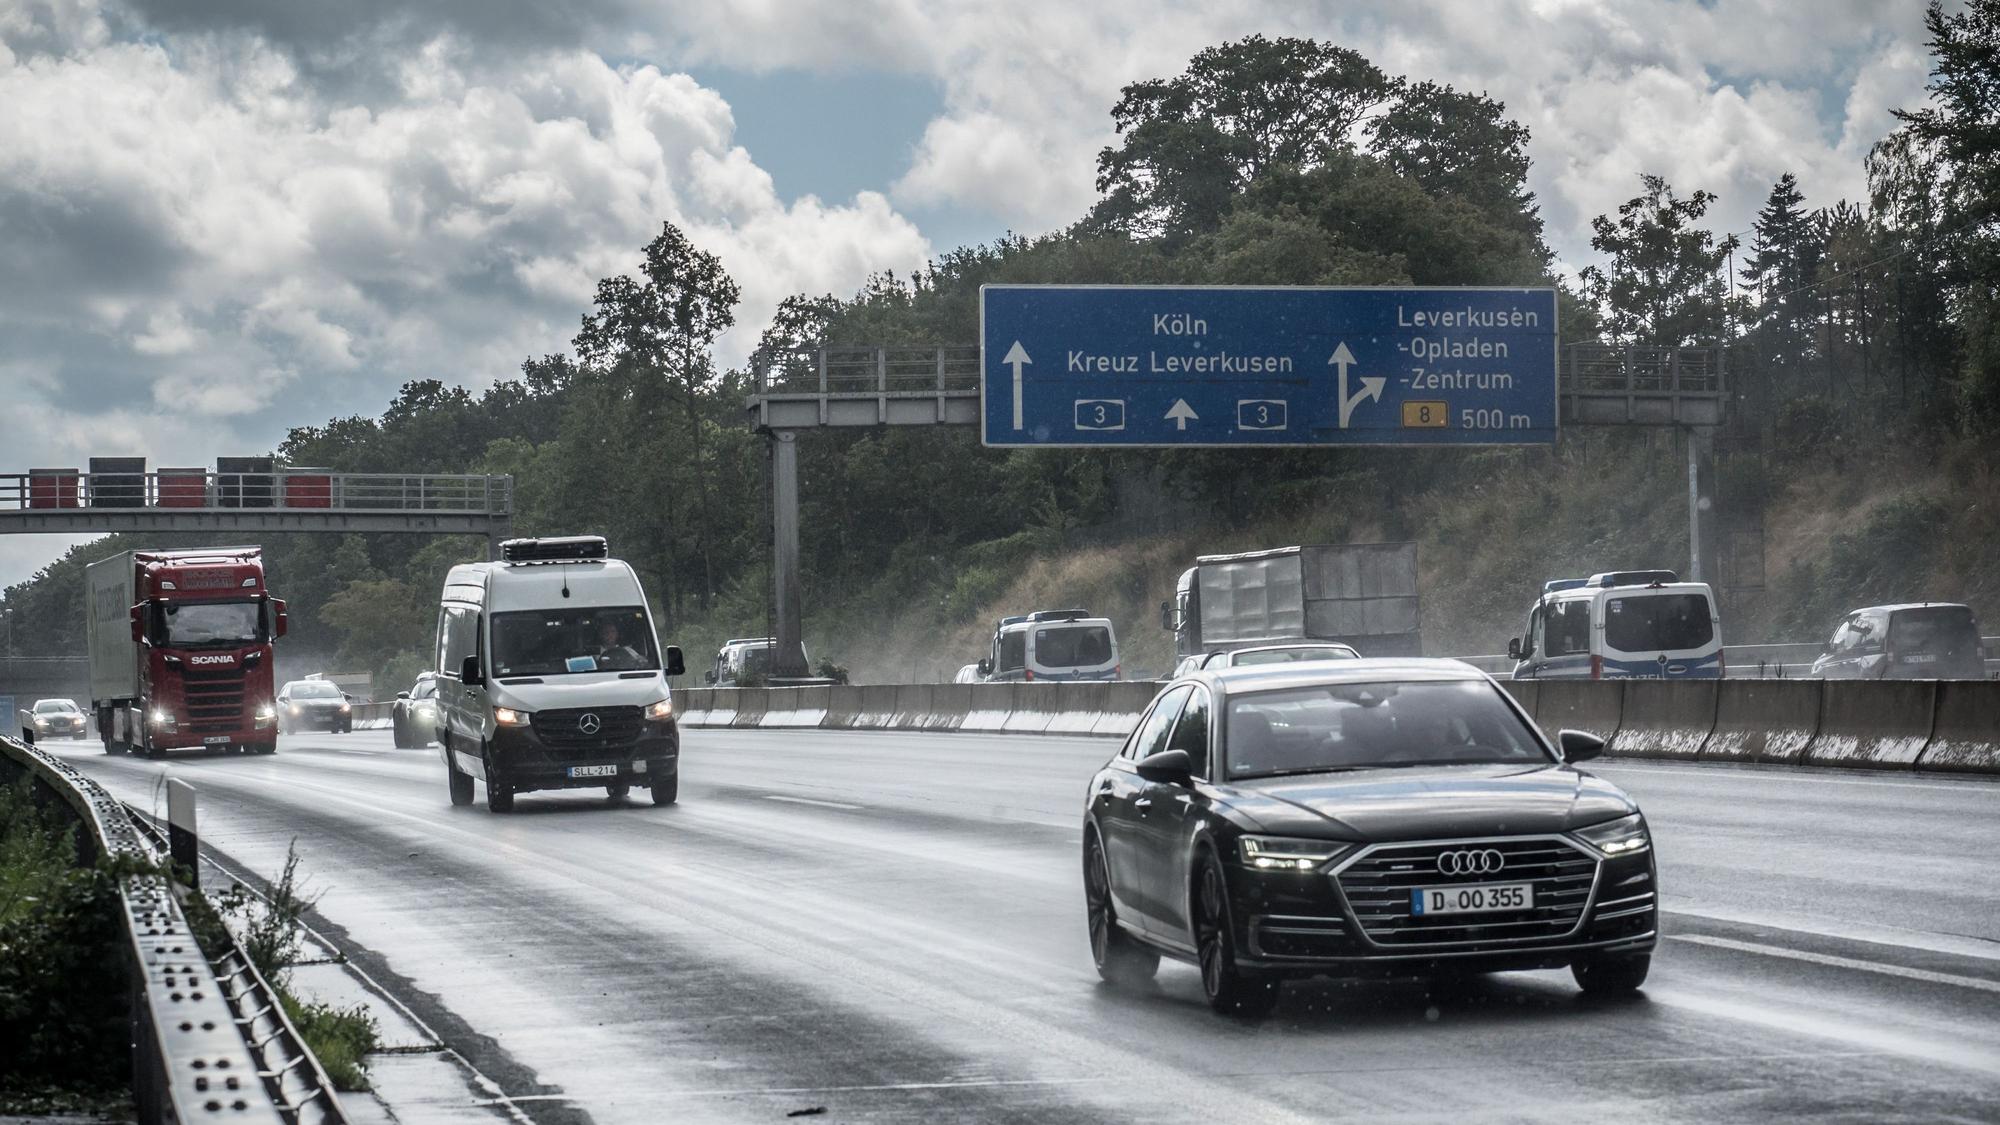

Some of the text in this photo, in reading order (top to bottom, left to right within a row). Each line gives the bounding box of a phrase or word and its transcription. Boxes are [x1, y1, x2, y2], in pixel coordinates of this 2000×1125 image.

[1154, 313, 1207, 335] Köln
[1398, 306, 1538, 327] Leverkusen
[1399, 337, 1508, 362] -Opladen
[1068, 351, 1292, 372] Kreuz Leverkusen
[1400, 369, 1512, 389] -Zentrum
[1095, 406, 1105, 424] 3
[1258, 406, 1268, 424] 3
[1420, 405, 1431, 424] 8
[1462, 409, 1530, 429] 500 m
[191, 655, 234, 664] SCANIA
[574, 766, 615, 776] SLL-214
[1432, 891, 1444, 911] D
[1488, 887, 1524, 907] 355
